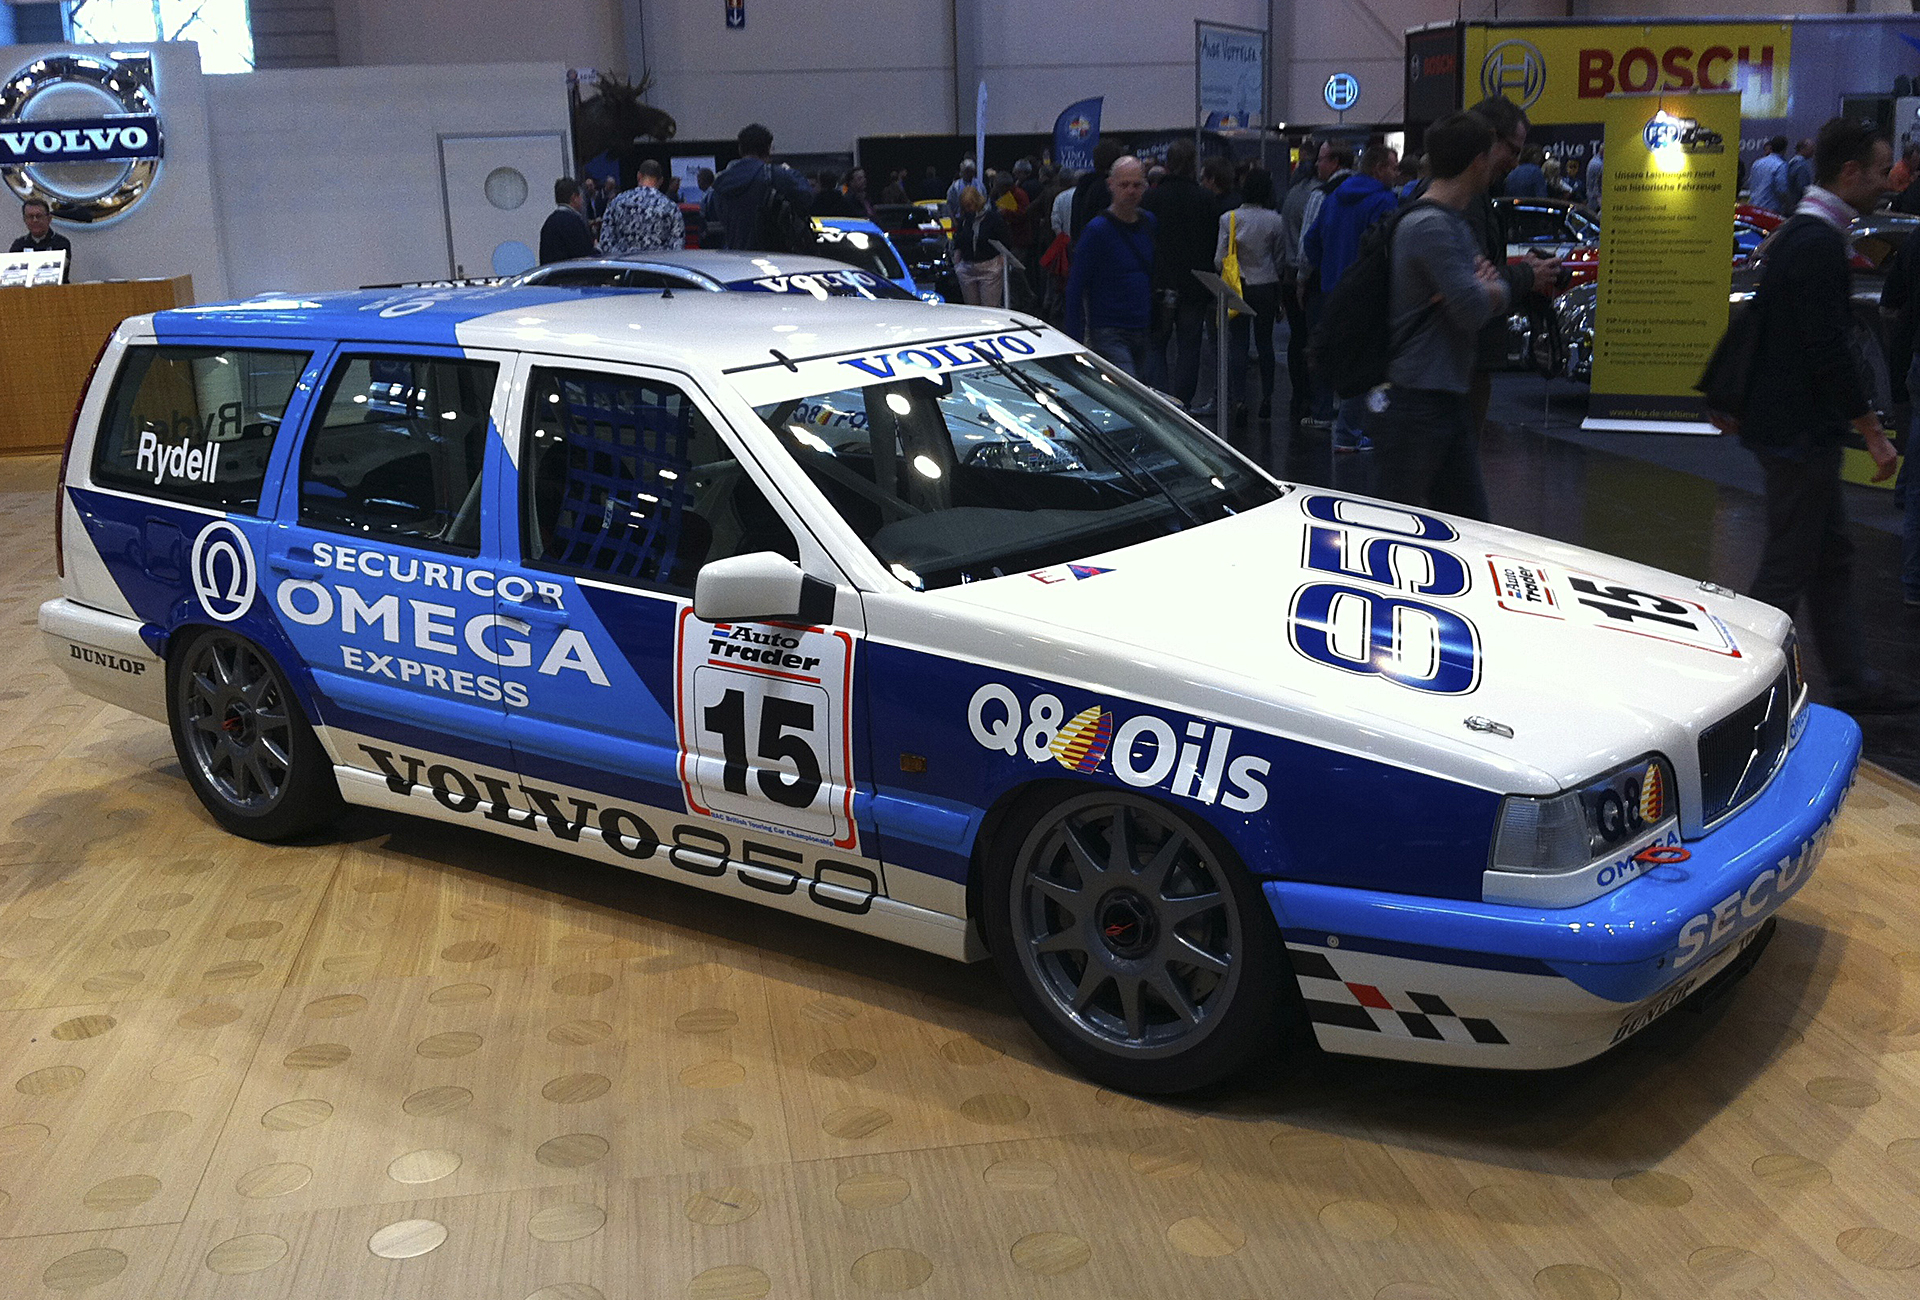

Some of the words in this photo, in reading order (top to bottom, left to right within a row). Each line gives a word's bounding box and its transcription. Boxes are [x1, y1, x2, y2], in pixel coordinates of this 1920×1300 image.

[1579, 45, 1774, 99] BOSCH
[0, 126, 148, 155] VOLVO
[1649, 126, 1678, 143] FSP
[753, 273, 876, 293] VOLVO
[838, 335, 1035, 378] VOLVO
[136, 431, 220, 485] Rydell
[313, 542, 563, 610] SECURICOR
[1287, 495, 1482, 696] 850
[1517, 565, 1542, 603] Trader
[1567, 576, 1699, 631] 15
[69, 644, 146, 675] DUNLOP
[277, 578, 610, 687] OMEGA
[709, 639, 820, 671] Trader
[729, 626, 799, 649] Auto
[340, 646, 528, 707] EXPRESS
[704, 688, 822, 808] 15
[968, 683, 1064, 762] Q8
[1111, 715, 1271, 813] Oils
[357, 744, 658, 860] VOLVO
[669, 824, 878, 915] 850
[1597, 777, 1643, 842] Q8
